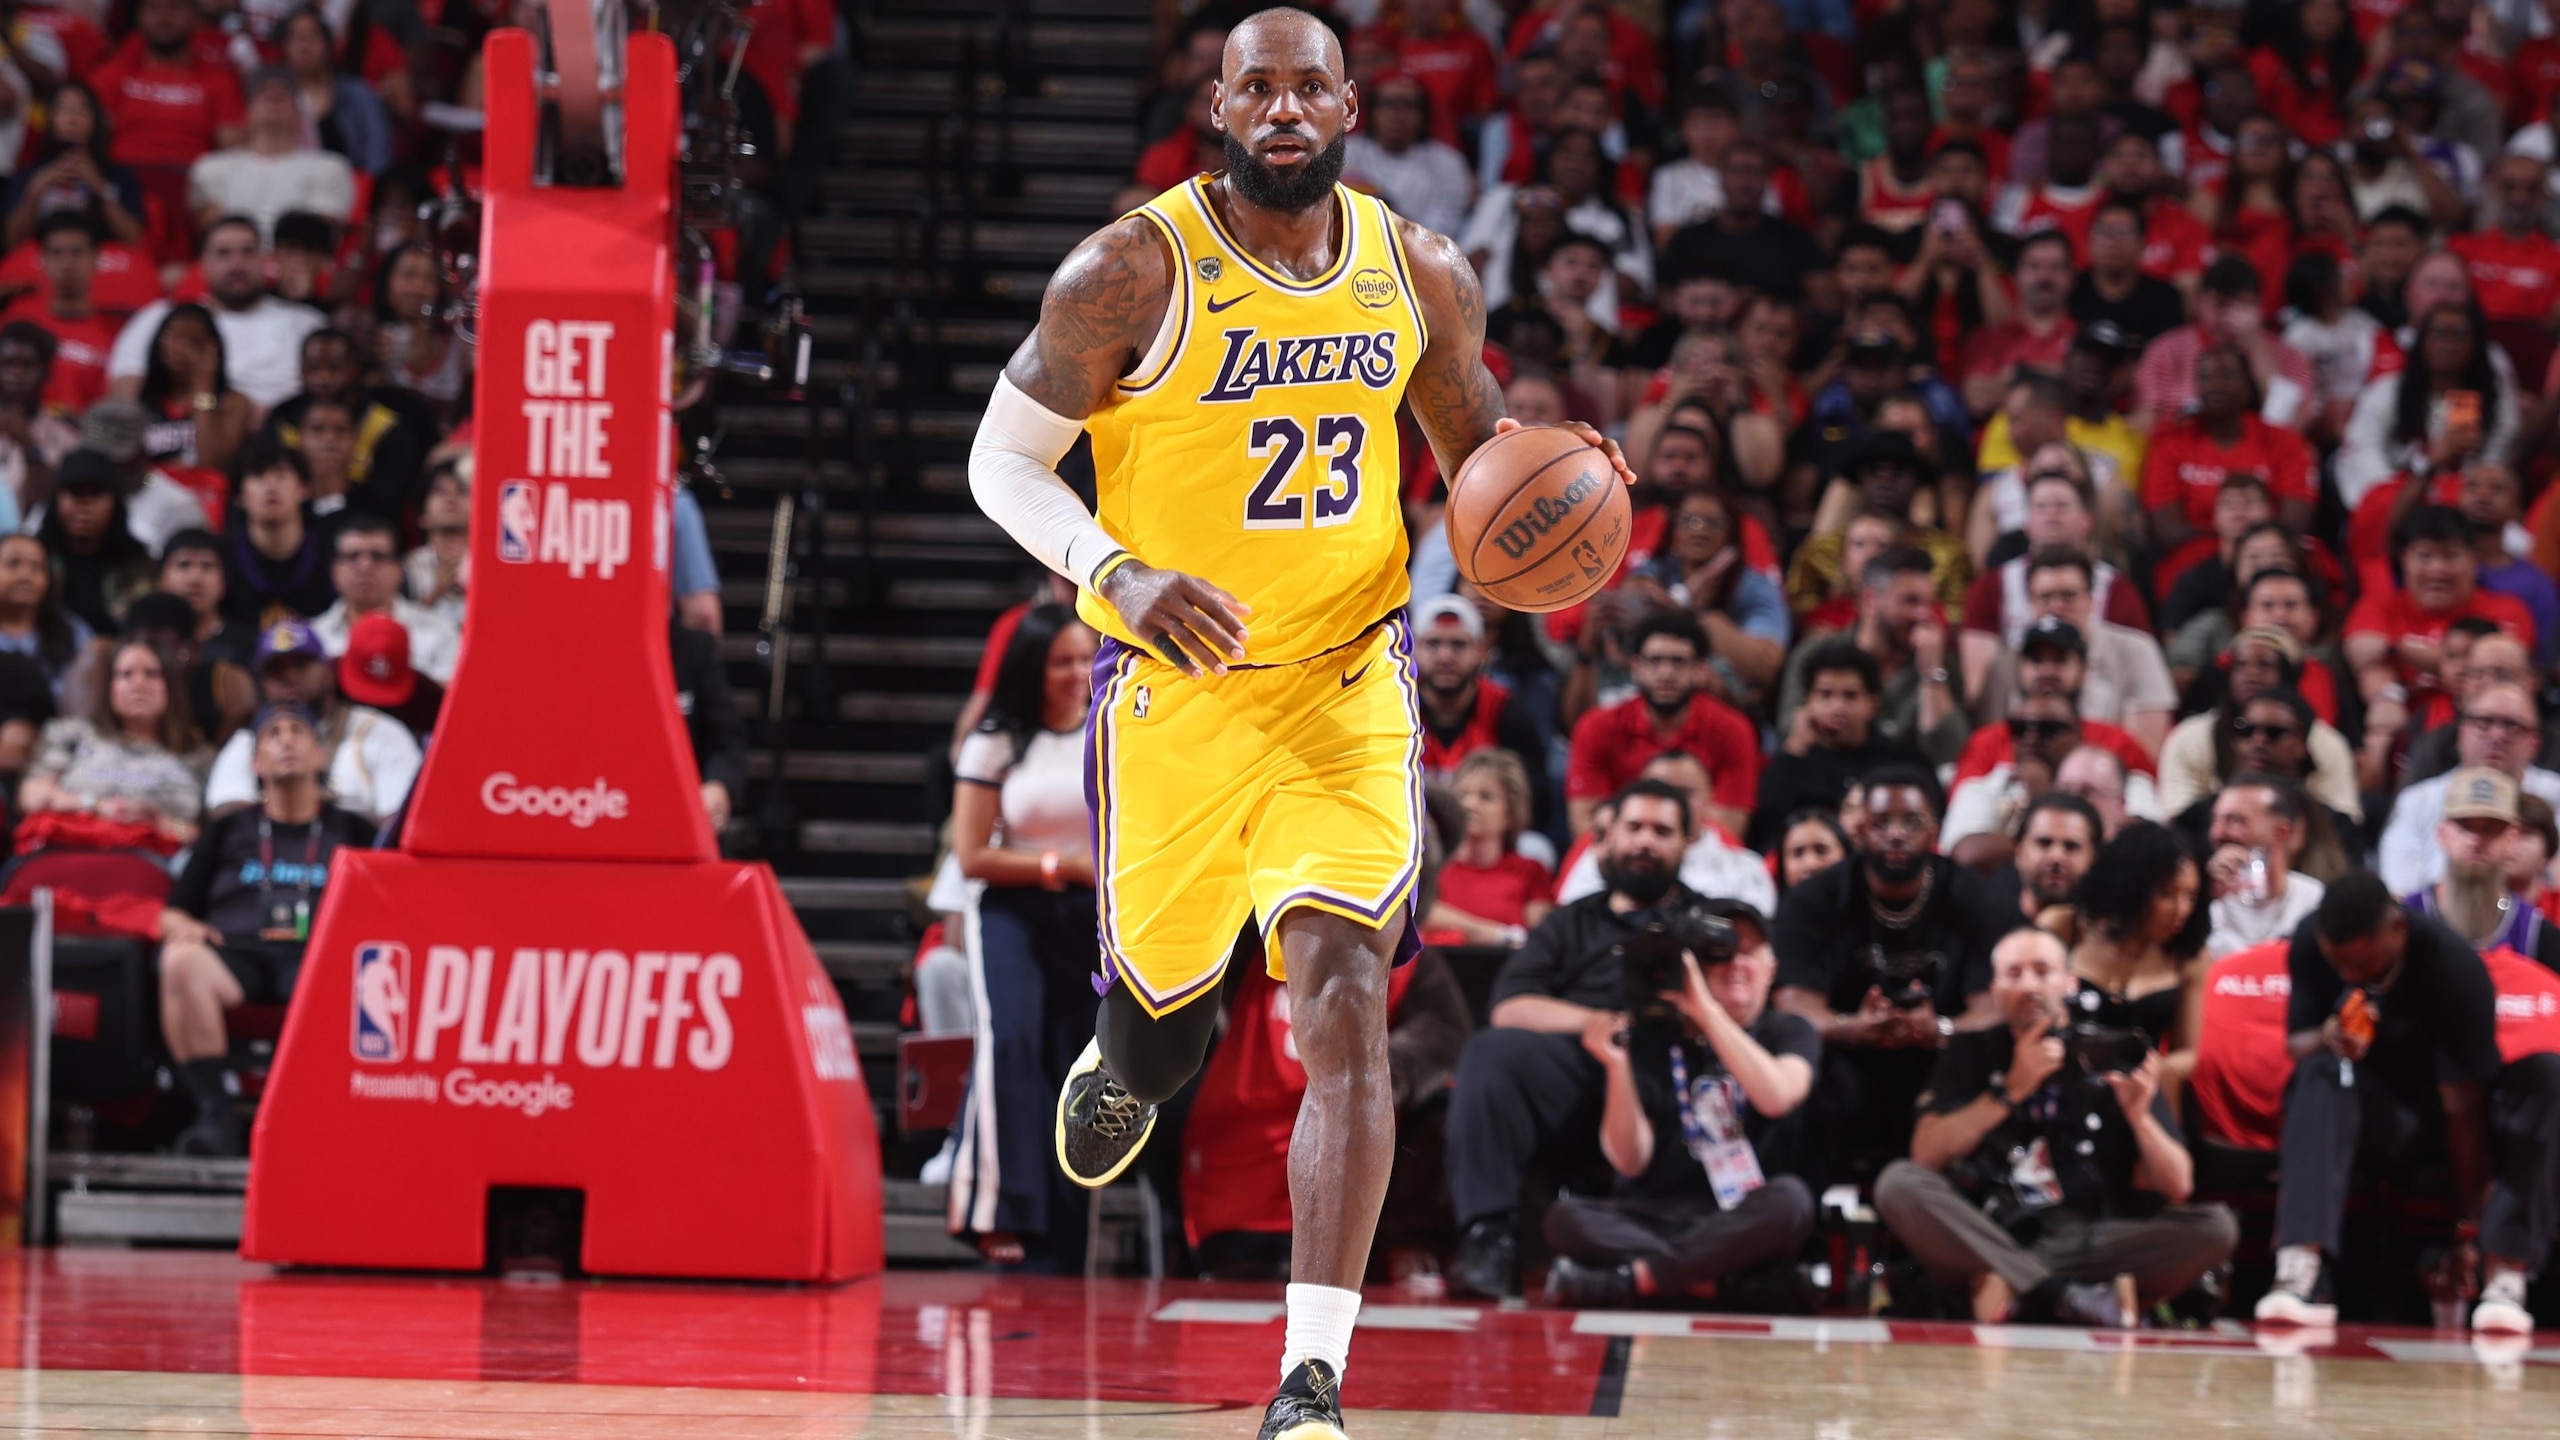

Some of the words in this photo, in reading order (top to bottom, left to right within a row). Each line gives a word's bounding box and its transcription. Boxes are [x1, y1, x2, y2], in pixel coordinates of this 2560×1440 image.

[1355, 279, 1394, 296] bibigo
[523, 318, 616, 398] GET
[1196, 326, 1400, 404] LAKERS
[521, 401, 614, 479] THE
[1242, 412, 1369, 530] 23
[539, 482, 632, 580] App
[1494, 469, 1600, 560] Wilson
[480, 770, 630, 829] Google
[413, 944, 744, 1072] PLAYOFFS
[443, 1067, 575, 1118] Google
